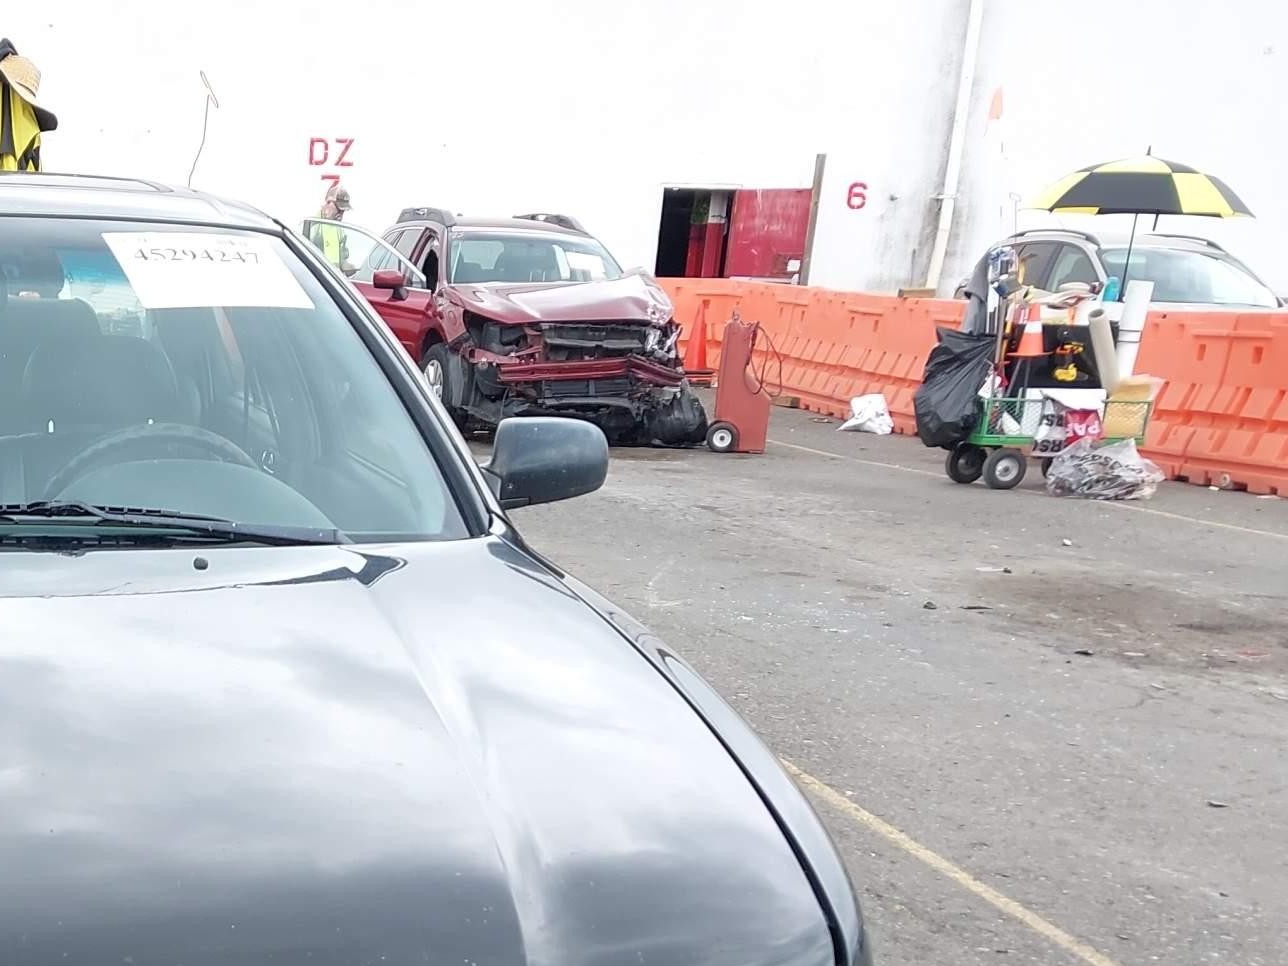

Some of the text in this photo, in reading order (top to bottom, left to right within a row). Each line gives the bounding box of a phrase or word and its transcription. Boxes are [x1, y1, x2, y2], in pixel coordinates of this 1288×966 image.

[309, 138, 354, 166] DZ
[847, 182, 868, 210] 6
[134, 247, 260, 264] 45294247
